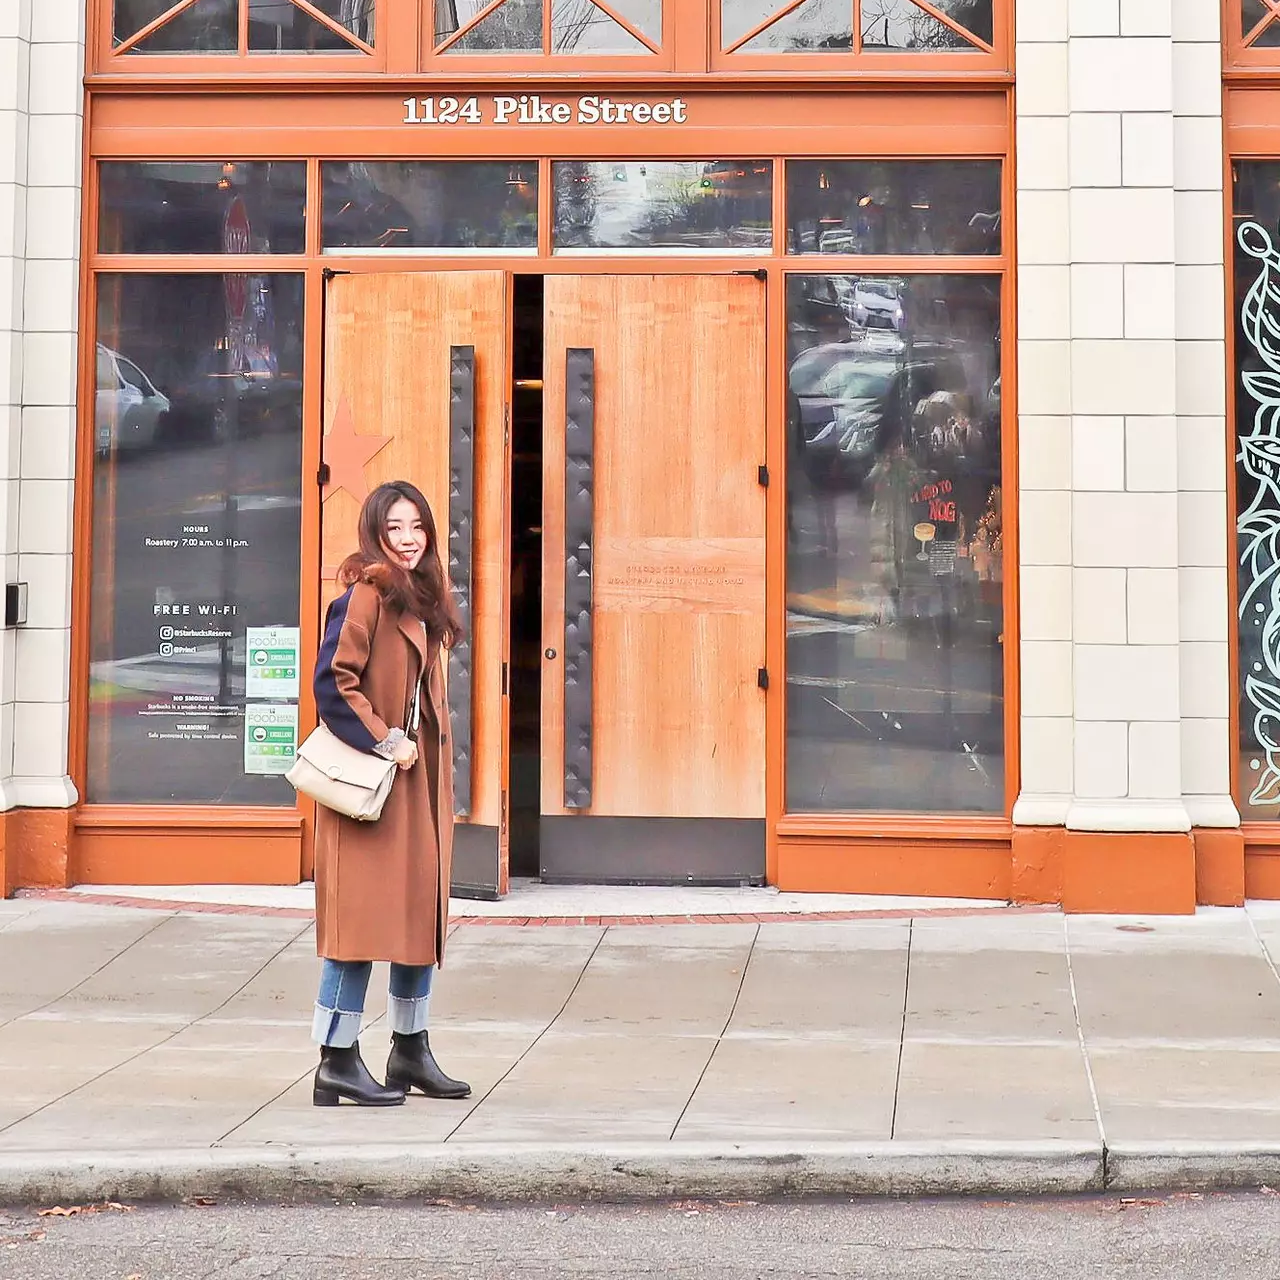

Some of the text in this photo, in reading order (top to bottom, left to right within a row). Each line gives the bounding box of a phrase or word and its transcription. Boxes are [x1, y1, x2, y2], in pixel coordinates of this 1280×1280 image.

[402, 95, 688, 124] 1124 Pike Street
[145, 538, 179, 548] Roastery
[216, 539, 224, 547] to
[153, 605, 237, 615] FREE WI-FI
